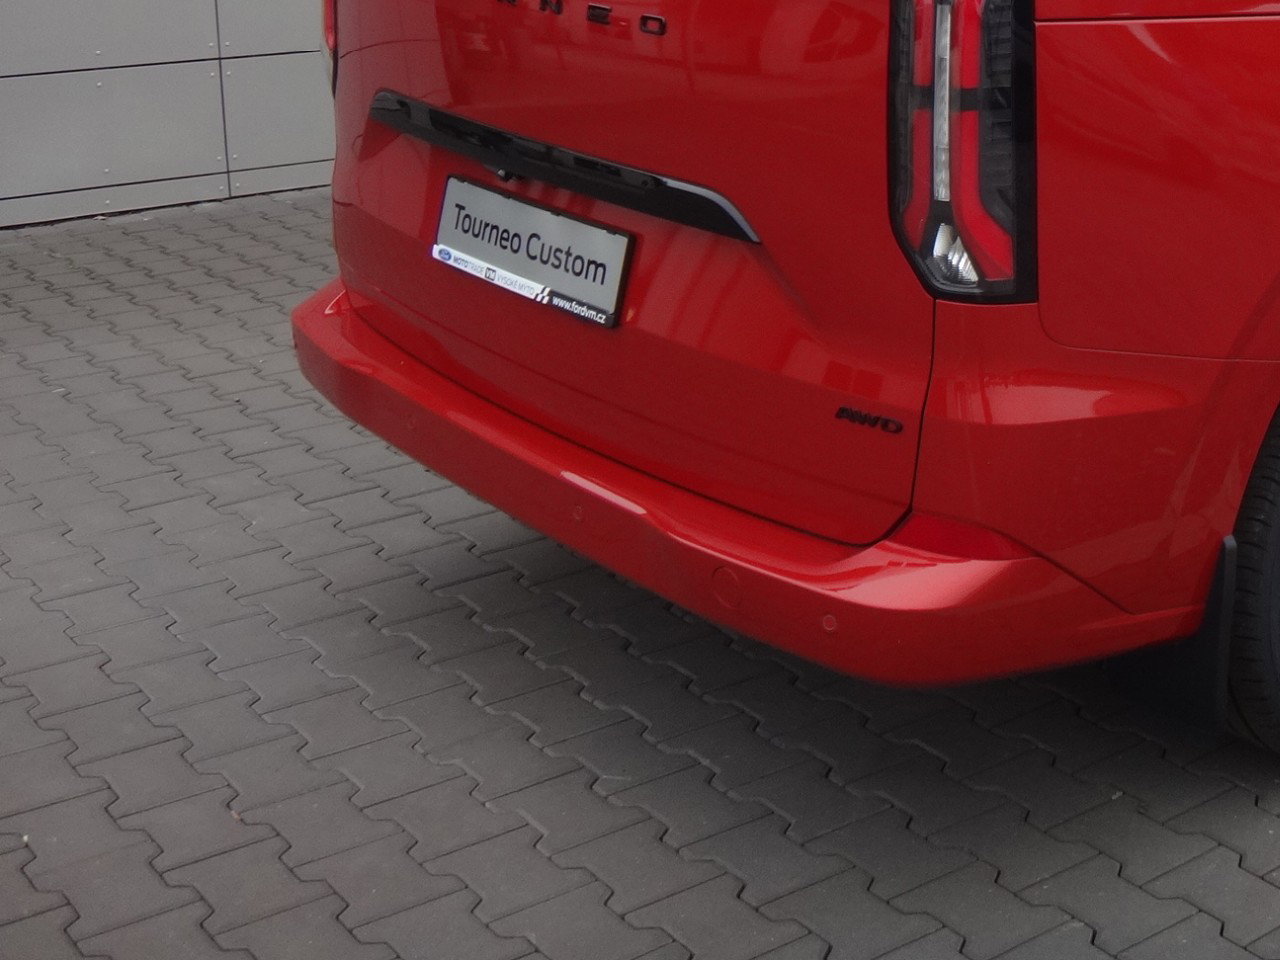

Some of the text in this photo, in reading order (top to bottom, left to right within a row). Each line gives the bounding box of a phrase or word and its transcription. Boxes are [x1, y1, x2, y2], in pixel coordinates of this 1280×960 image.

[453, 203, 607, 286] Tourneo Custom
[552, 294, 607, 324] www.fordvm.cz
[835, 406, 904, 434] AWD
